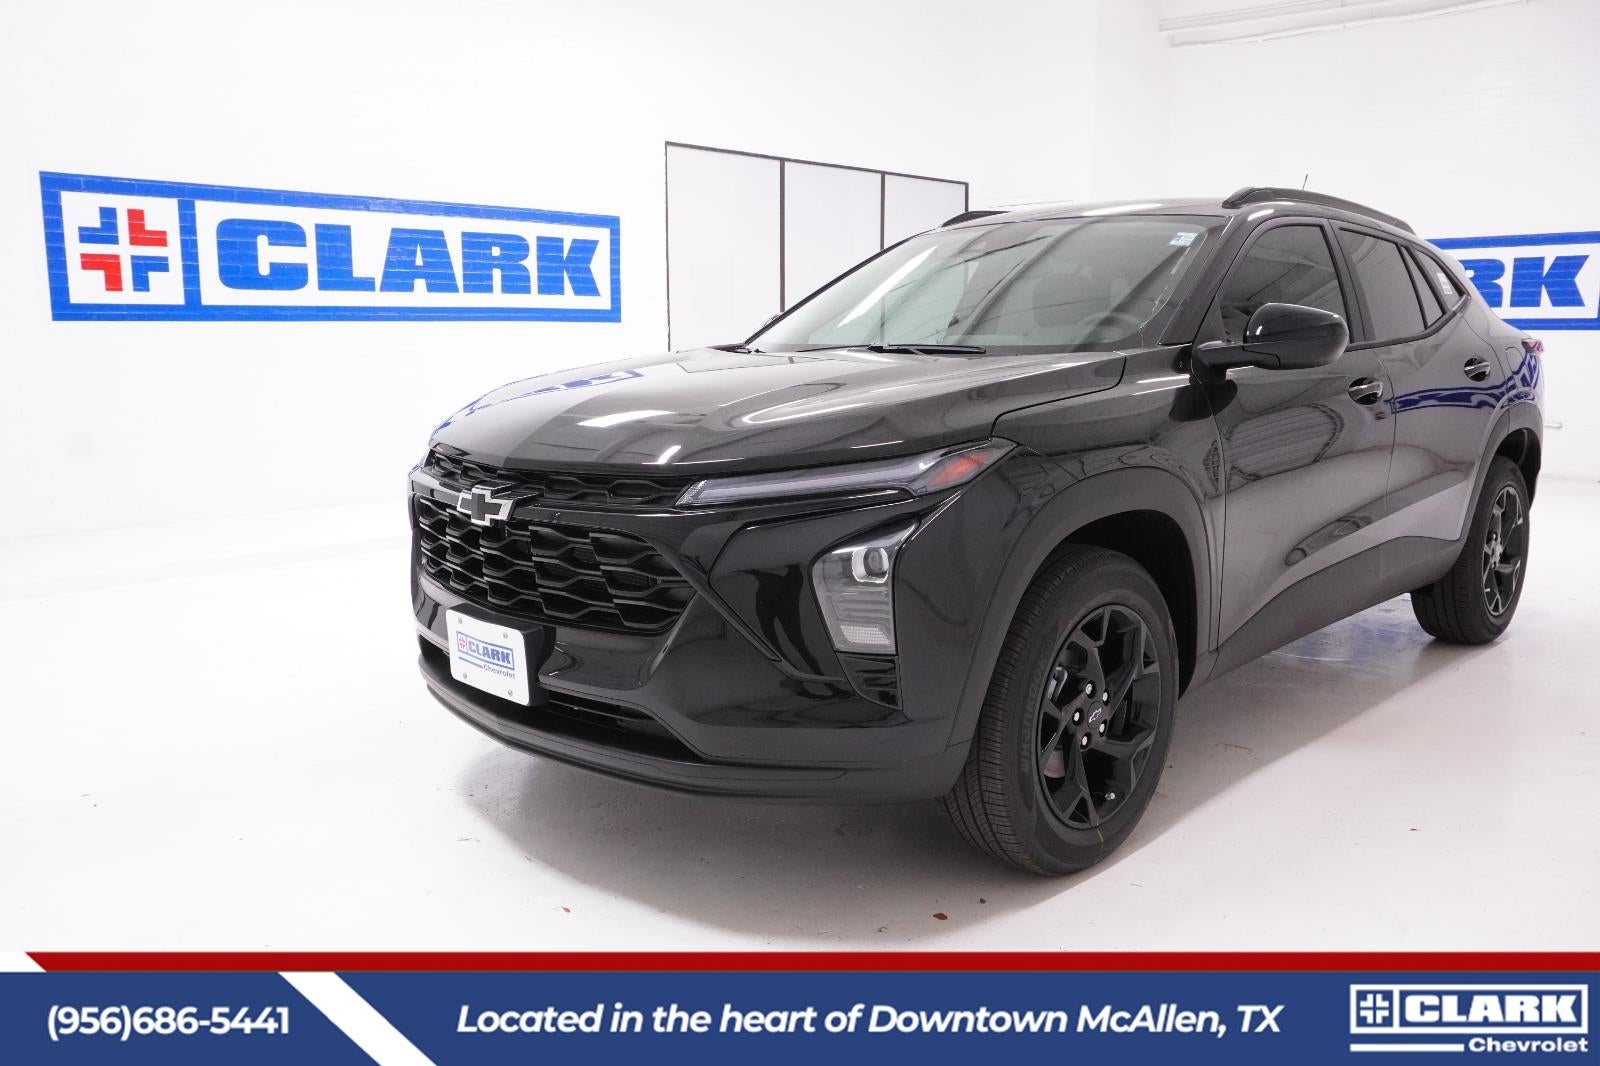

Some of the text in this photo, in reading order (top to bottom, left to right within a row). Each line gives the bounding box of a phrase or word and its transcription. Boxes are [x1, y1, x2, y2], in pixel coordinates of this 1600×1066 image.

[216, 218, 601, 297] CLARK
[468, 640, 511, 665] CLARK
[483, 664, 516, 680] Chevrolet
